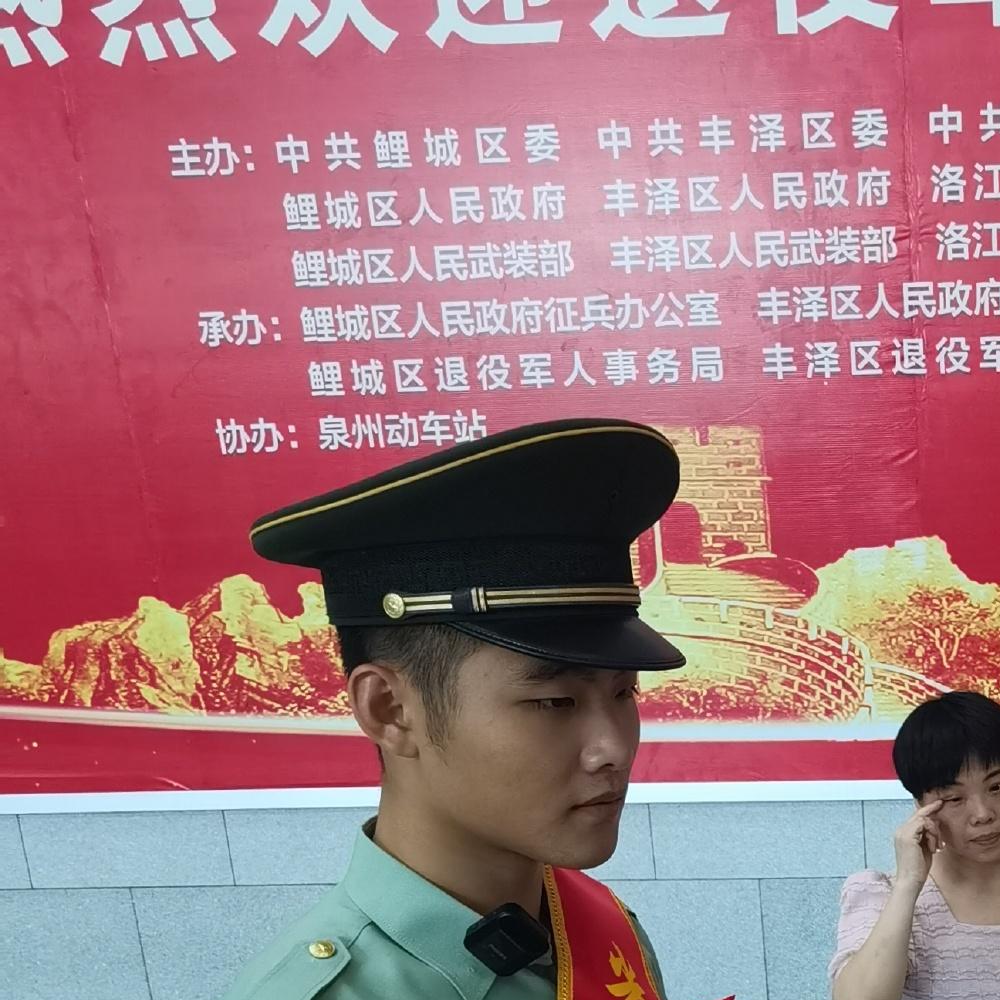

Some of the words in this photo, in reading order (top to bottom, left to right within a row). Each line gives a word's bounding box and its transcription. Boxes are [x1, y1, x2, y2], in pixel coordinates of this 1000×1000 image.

[596, 108, 889, 160] 中共丰泽区委
[282, 182, 567, 231] 鲤城区人民政府
[602, 166, 892, 217] 丰泽区人民政府
[290, 240, 574, 288] 鲤城区人民武装部
[609, 225, 899, 274] 丰泽区人民武装部
[307, 345, 724, 397] 鲤城区退役军人事务局
